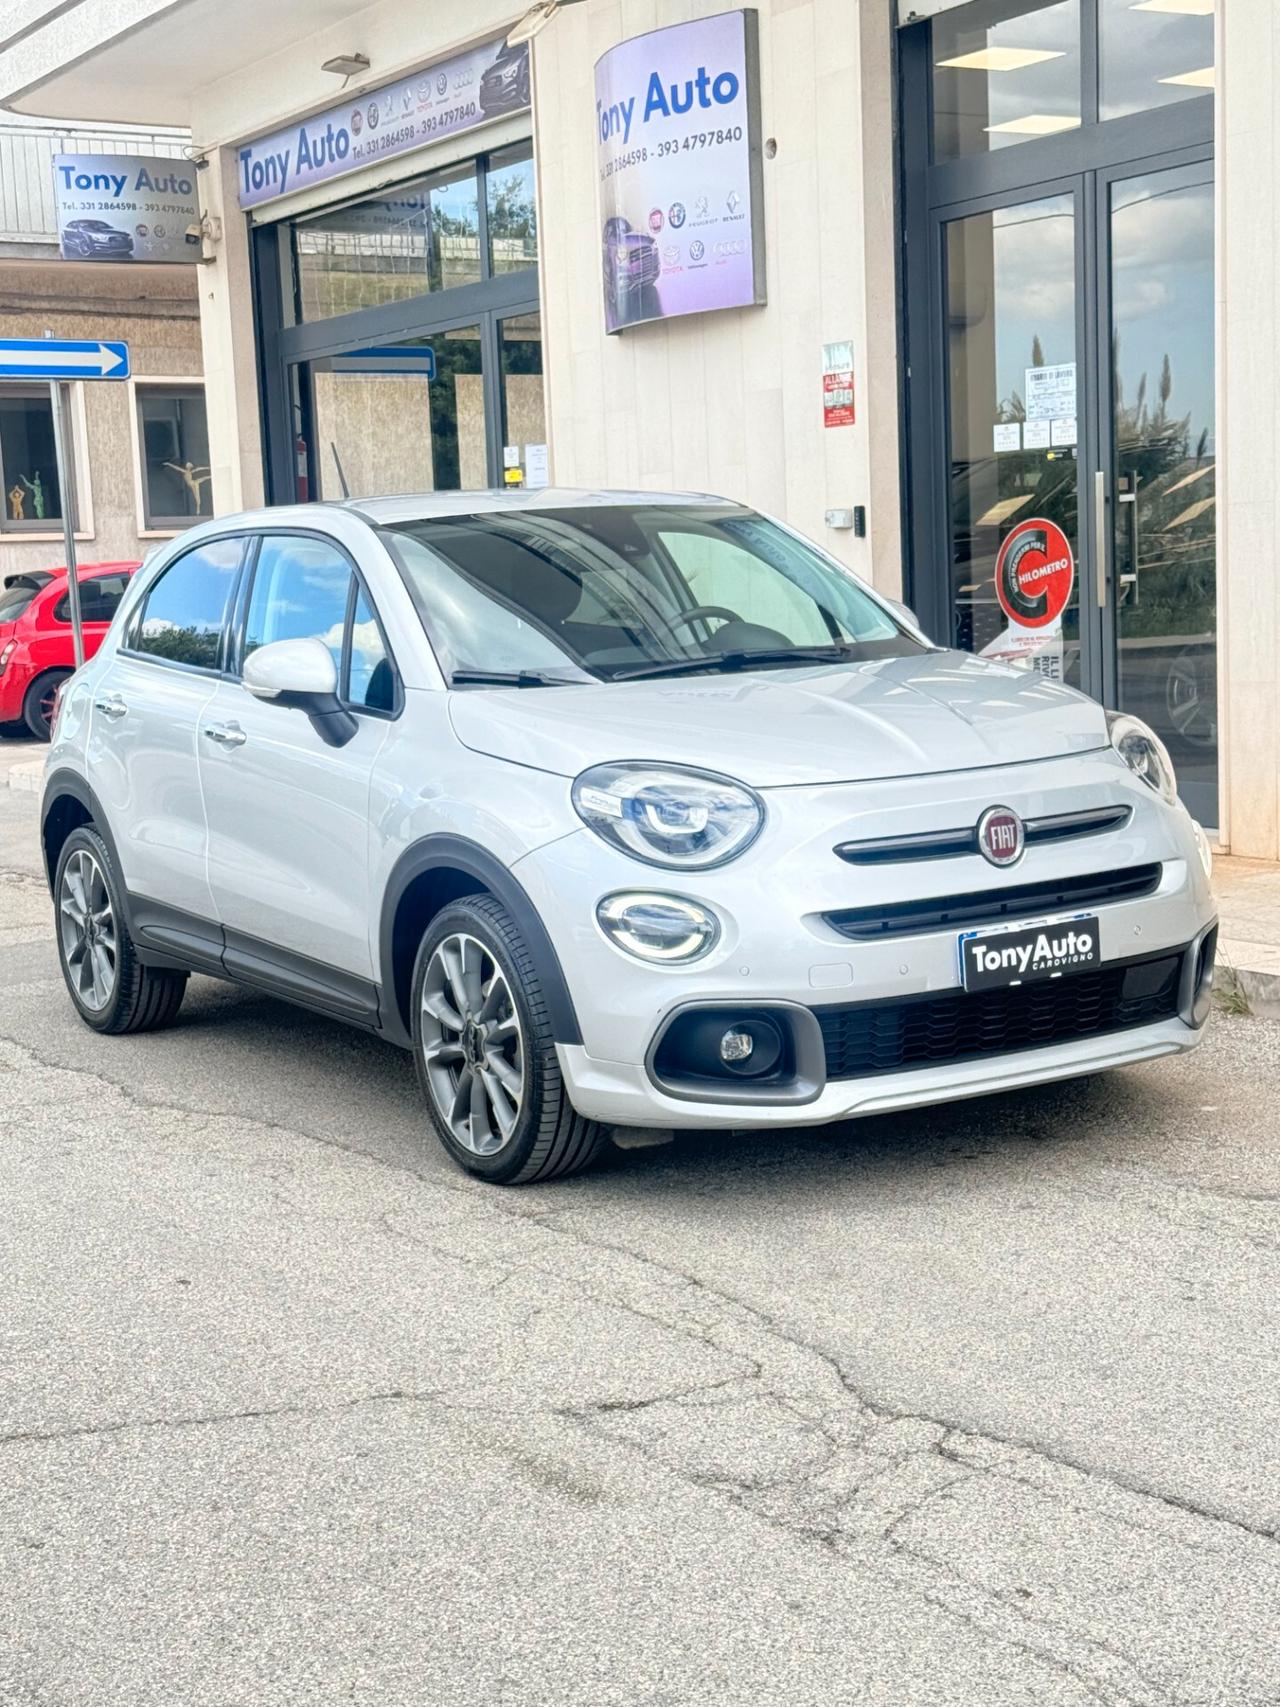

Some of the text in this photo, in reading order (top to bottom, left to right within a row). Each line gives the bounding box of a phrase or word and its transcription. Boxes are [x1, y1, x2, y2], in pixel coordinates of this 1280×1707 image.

[597, 67, 739, 145] Tony Auto
[353, 144, 366, 161] Tel.
[366, 140, 380, 157] 331
[380, 128, 415, 152] 2864598
[421, 119, 437, 136] 393
[438, 102, 476, 127] 4797840
[614, 147, 648, 173] 2864598
[657, 139, 679, 158] 393
[682, 126, 742, 152] 4797840
[240, 123, 349, 194] Tony Auto
[59, 166, 193, 197] Tony Auto
[62, 202, 78, 211] Tel.
[80, 202, 95, 211] 331
[98, 202, 137, 212] 2864598
[144, 203, 160, 213] 393
[1050, 656, 1059, 667] IL
[990, 823, 1016, 850] FIAT
[972, 931, 1093, 973] TonyAuto
[1032, 952, 1093, 970] CAROVIGNO
